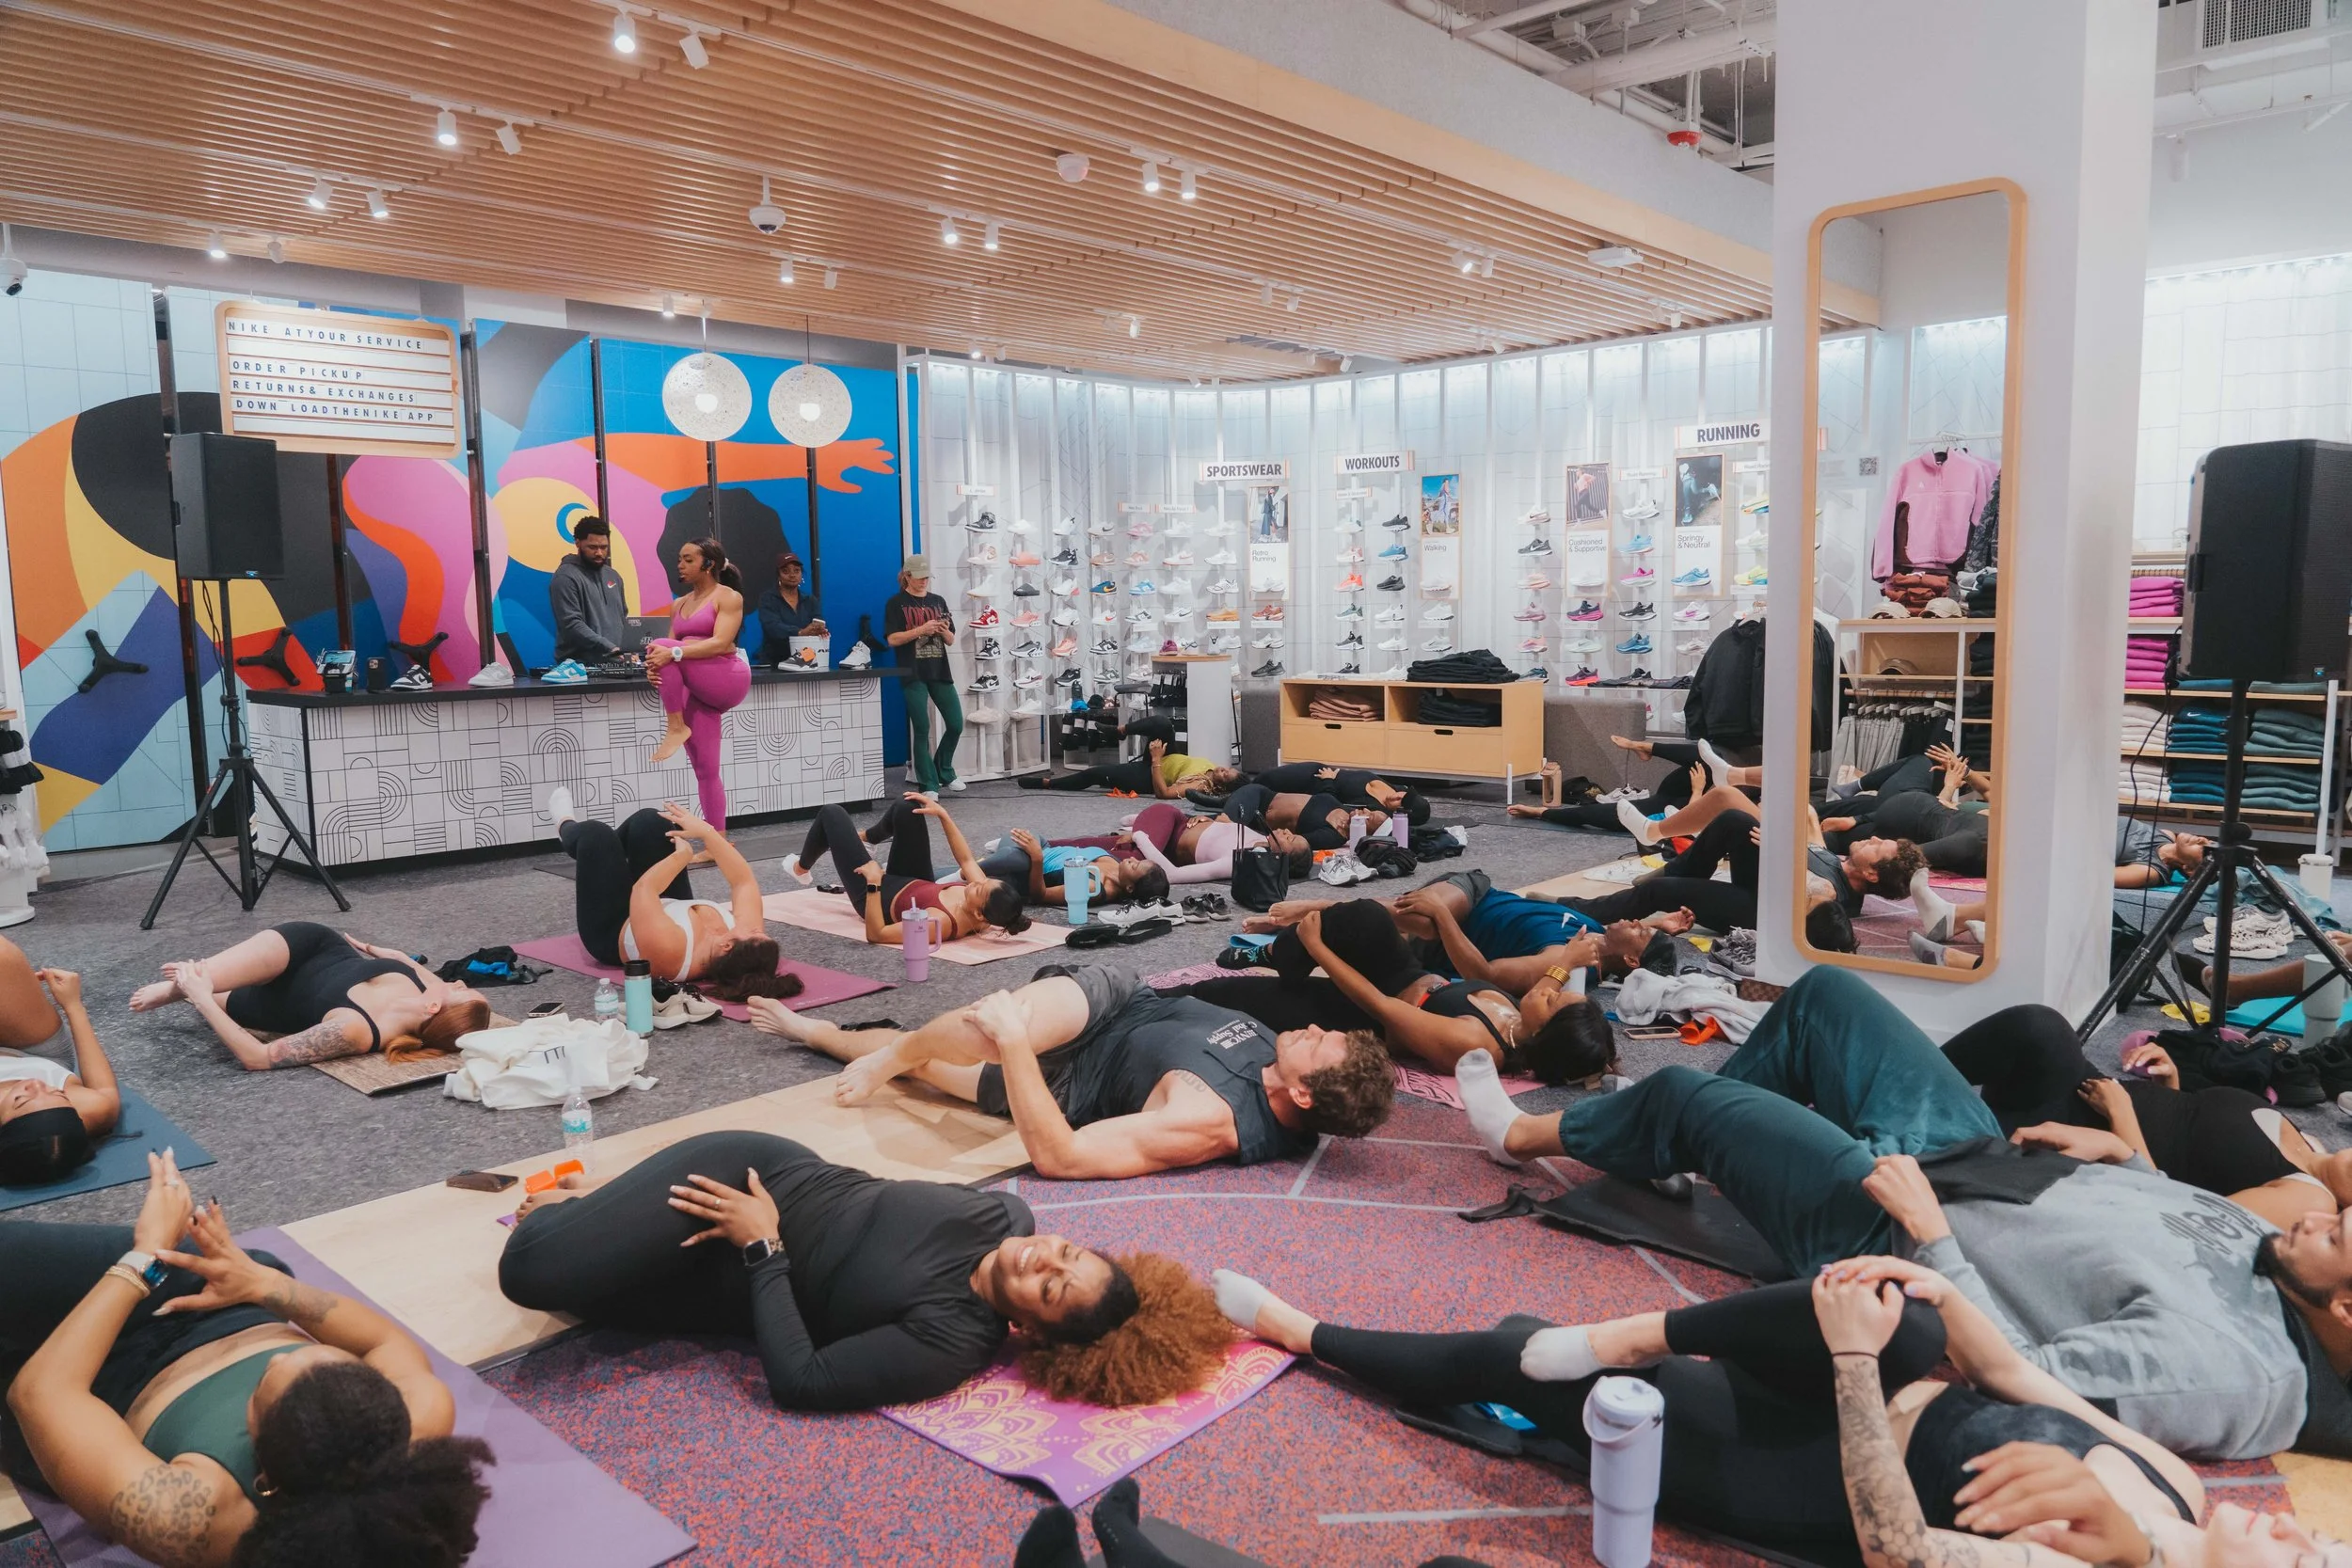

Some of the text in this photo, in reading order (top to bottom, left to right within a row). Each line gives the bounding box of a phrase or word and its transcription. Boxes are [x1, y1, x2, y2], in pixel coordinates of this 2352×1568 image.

[229, 322, 268, 334] NIKE
[358, 335, 421, 350] SERVICE
[232, 360, 286, 373] ORDER
[328, 388, 415, 403] EXCHANGES
[408, 412, 433, 421] APP
[1697, 423, 1760, 443] RUNNING
[1344, 455, 1400, 470] WORKOUTS
[1206, 464, 1282, 477] SPORTSWEAR
[1568, 537, 1603, 546] Cushioned
[1677, 534, 1705, 544] Springy
[1229, 1031, 1249, 1046] NYC
